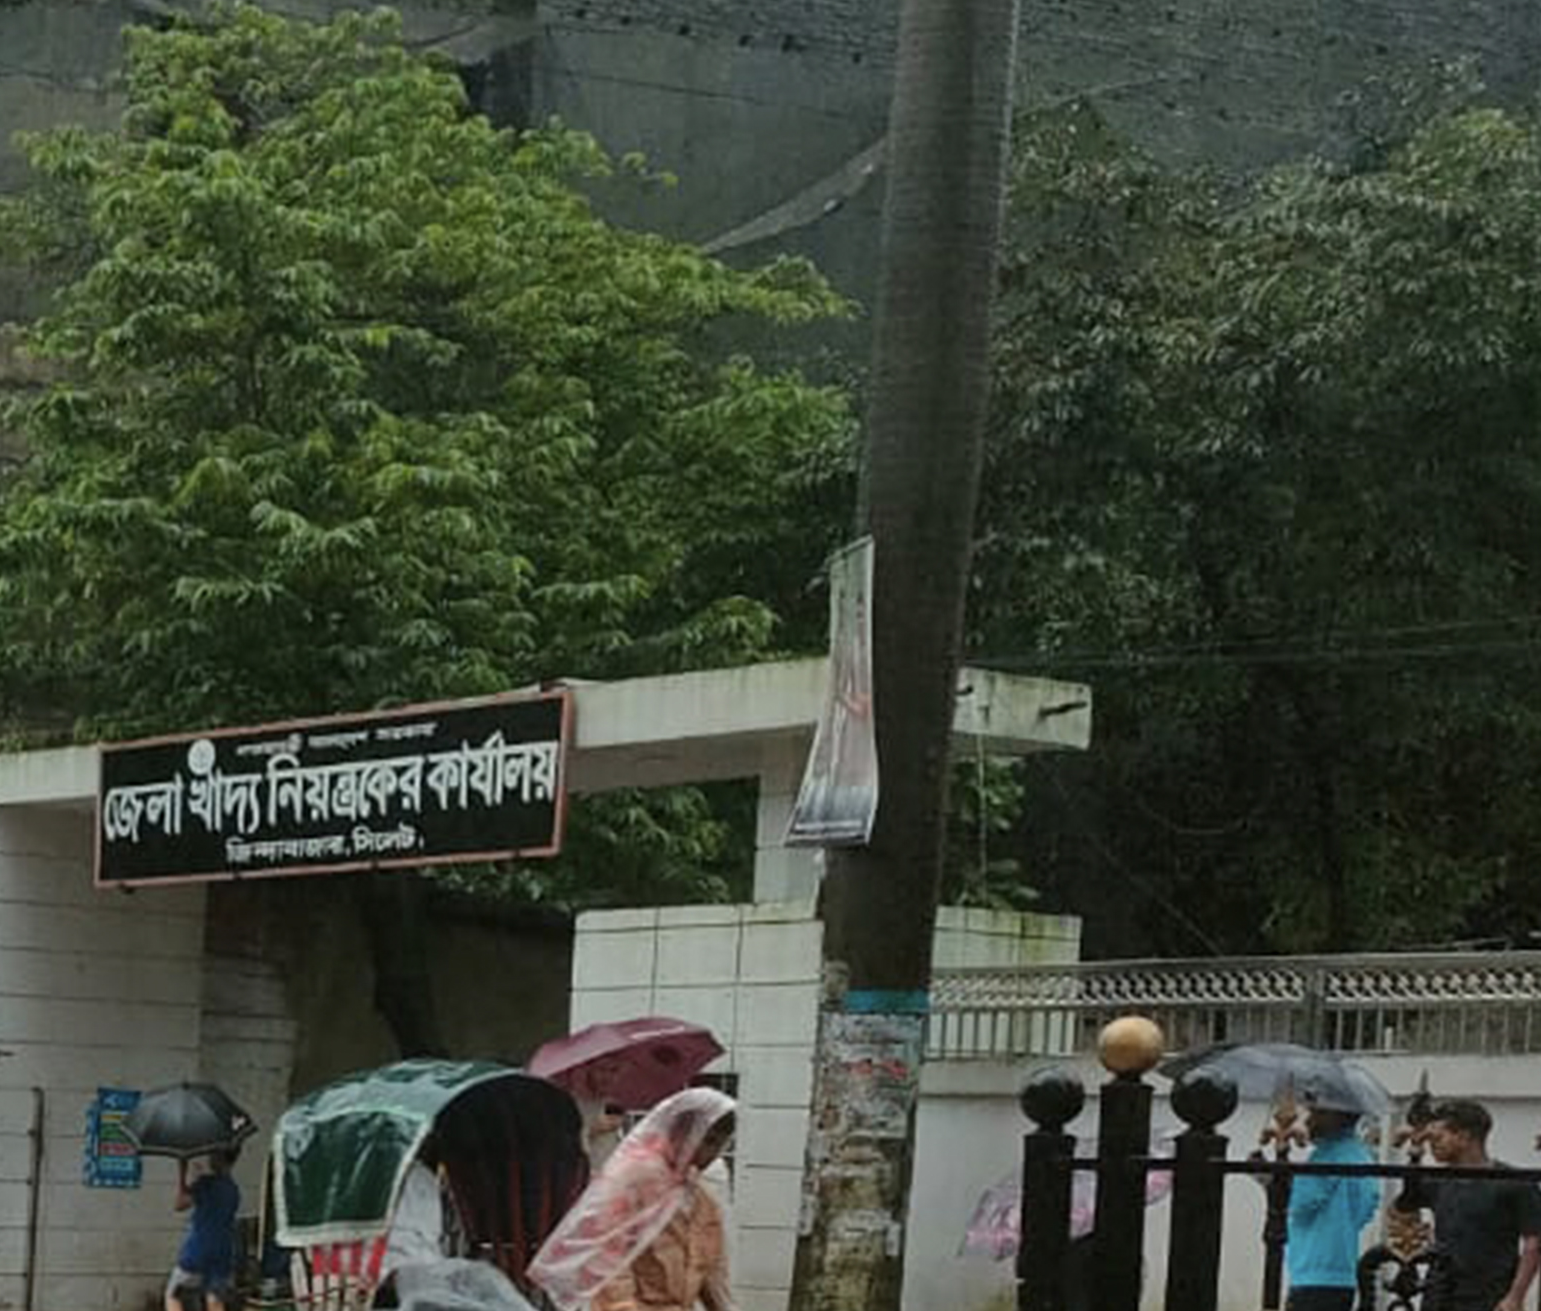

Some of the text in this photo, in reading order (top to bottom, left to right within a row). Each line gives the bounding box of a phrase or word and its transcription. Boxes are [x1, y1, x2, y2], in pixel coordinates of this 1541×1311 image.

[103, 770, 184, 843] জেলা
[188, 766, 262, 834] খাদ্য
[426, 730, 560, 811] কার্যালয়
